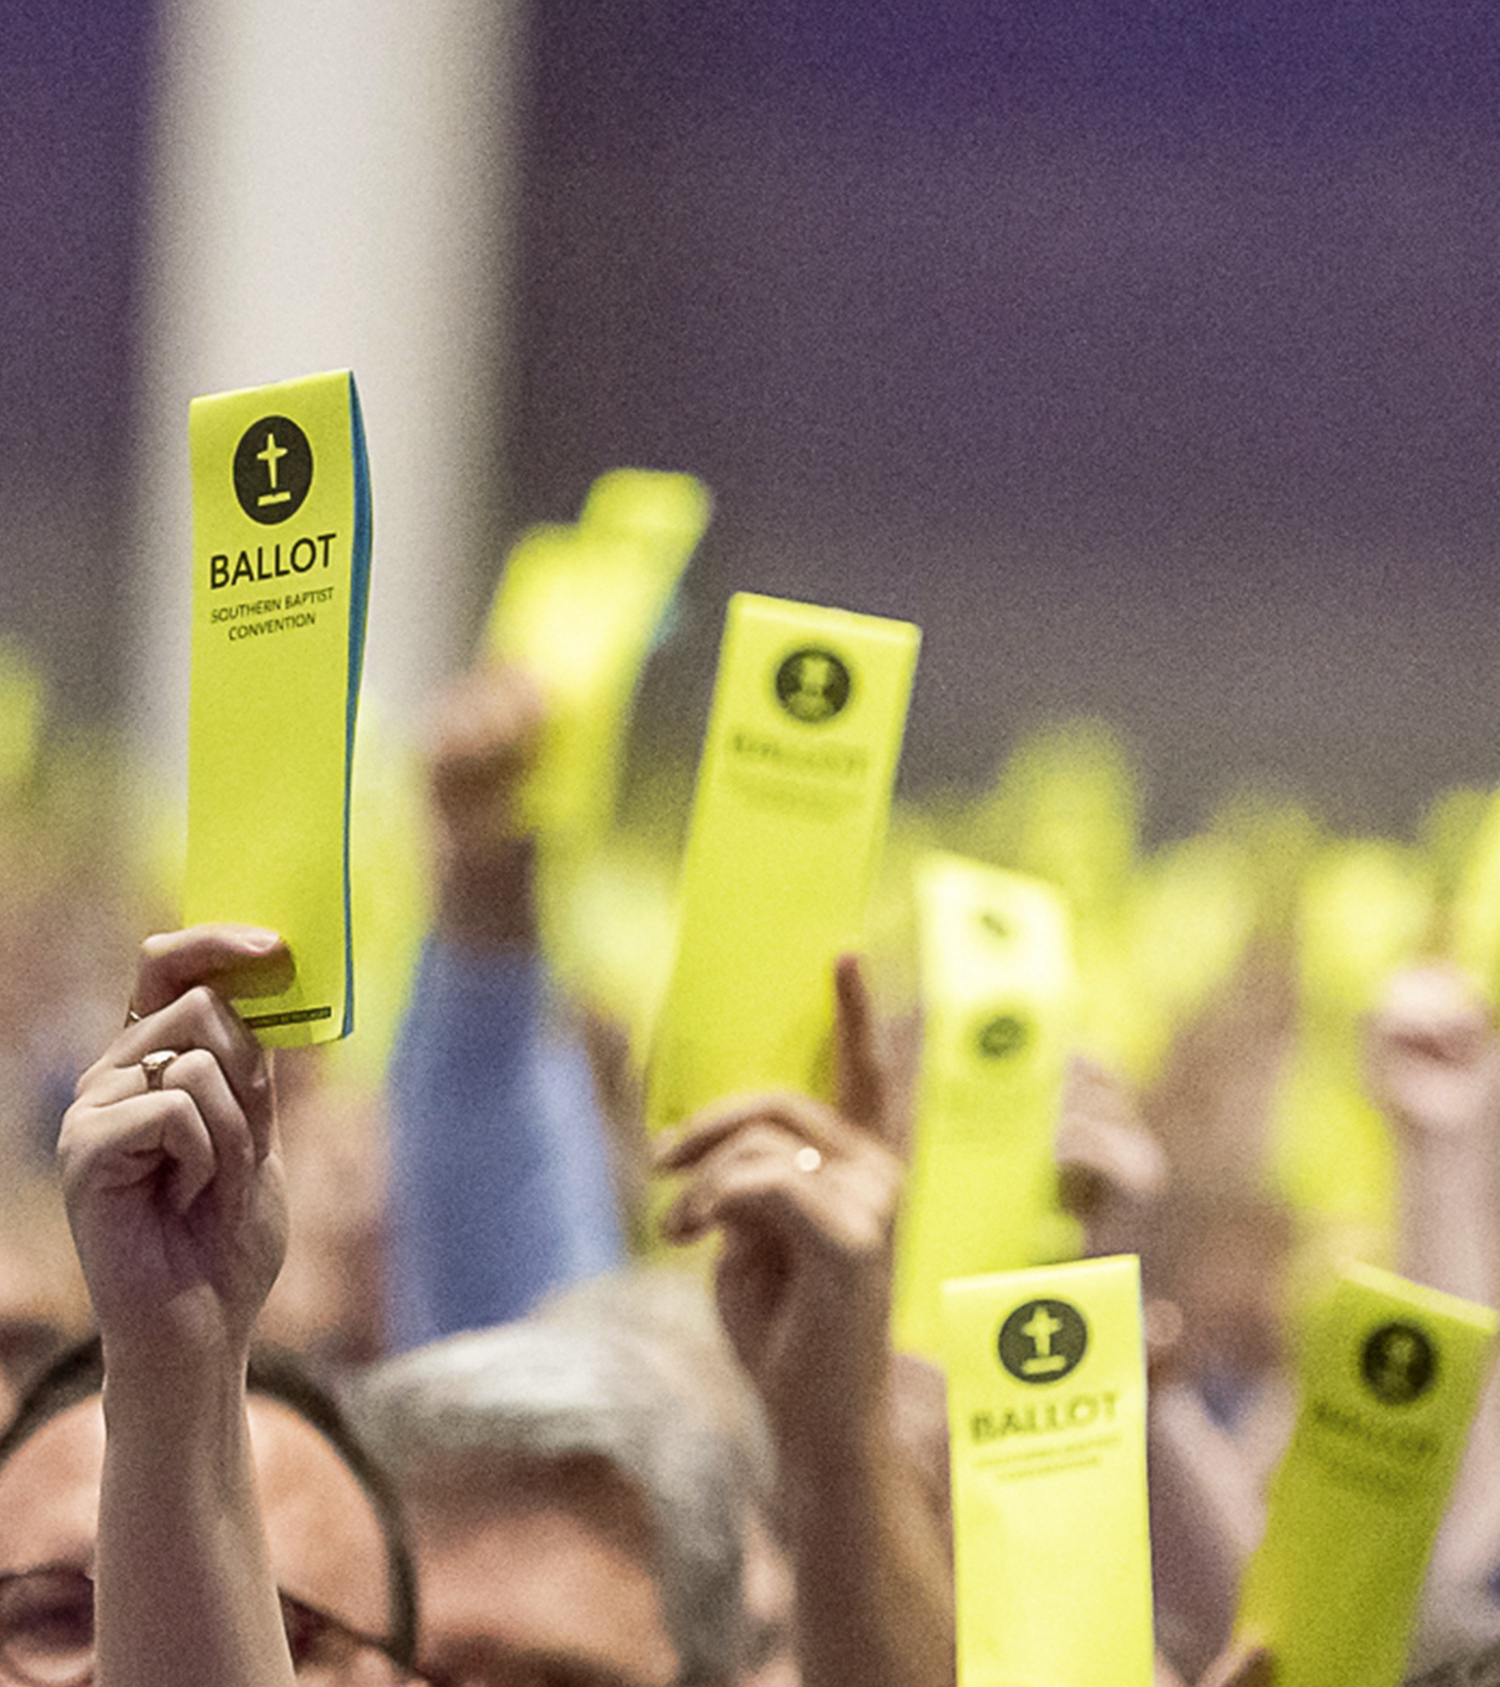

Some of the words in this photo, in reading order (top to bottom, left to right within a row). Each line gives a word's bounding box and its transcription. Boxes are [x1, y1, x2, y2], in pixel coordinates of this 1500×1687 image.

[210, 533, 337, 589] BALLOT
[210, 597, 282, 624] SOUTHERN
[284, 587, 334, 610] BAPTIST
[228, 612, 316, 641] CONVENTION
